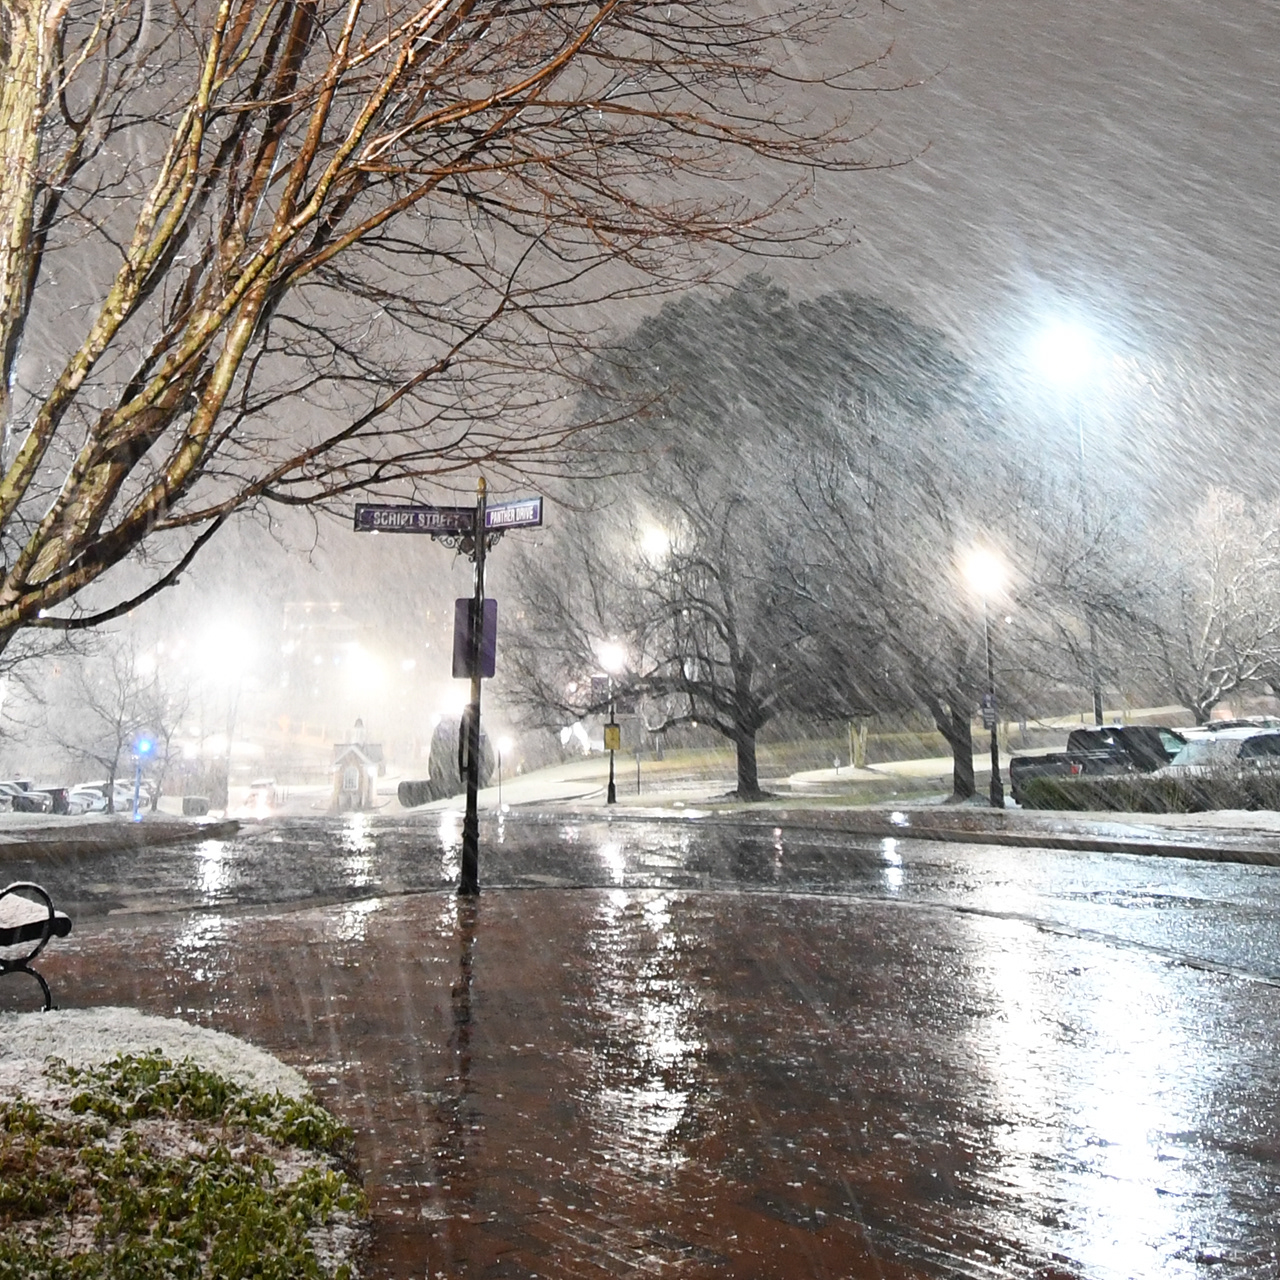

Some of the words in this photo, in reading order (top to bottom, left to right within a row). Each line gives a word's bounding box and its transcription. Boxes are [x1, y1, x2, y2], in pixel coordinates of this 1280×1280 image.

[418, 513, 460, 527] STREET
[490, 508, 515, 526] PANTHER
[516, 505, 534, 521] DRIVE
